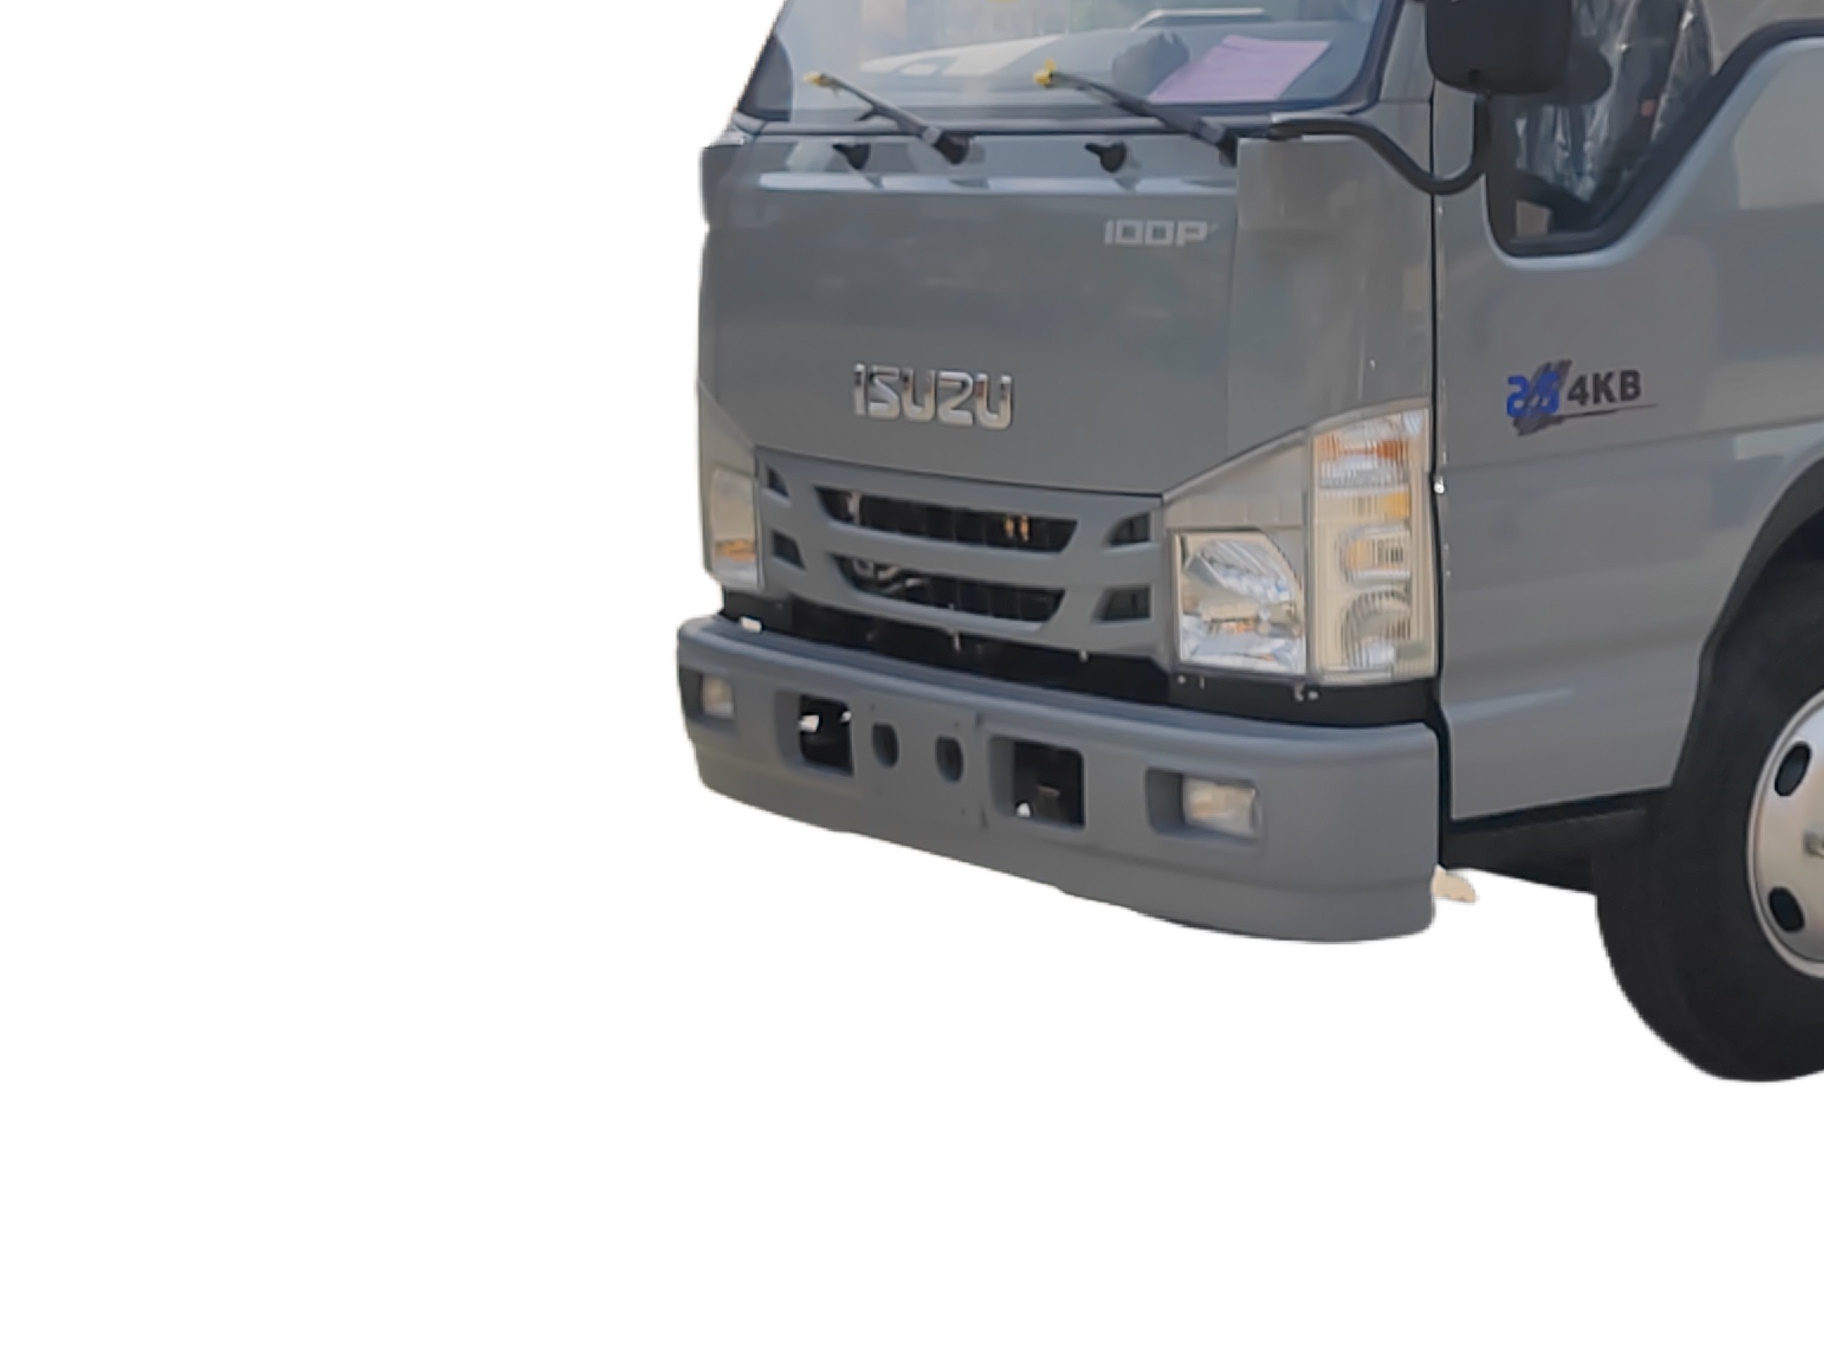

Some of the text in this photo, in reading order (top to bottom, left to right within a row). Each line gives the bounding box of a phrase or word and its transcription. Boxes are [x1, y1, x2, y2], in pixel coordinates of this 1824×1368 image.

[1104, 219, 1208, 247] 100P
[853, 362, 1012, 430] ISUZU
[1567, 369, 1642, 407] 4KB
